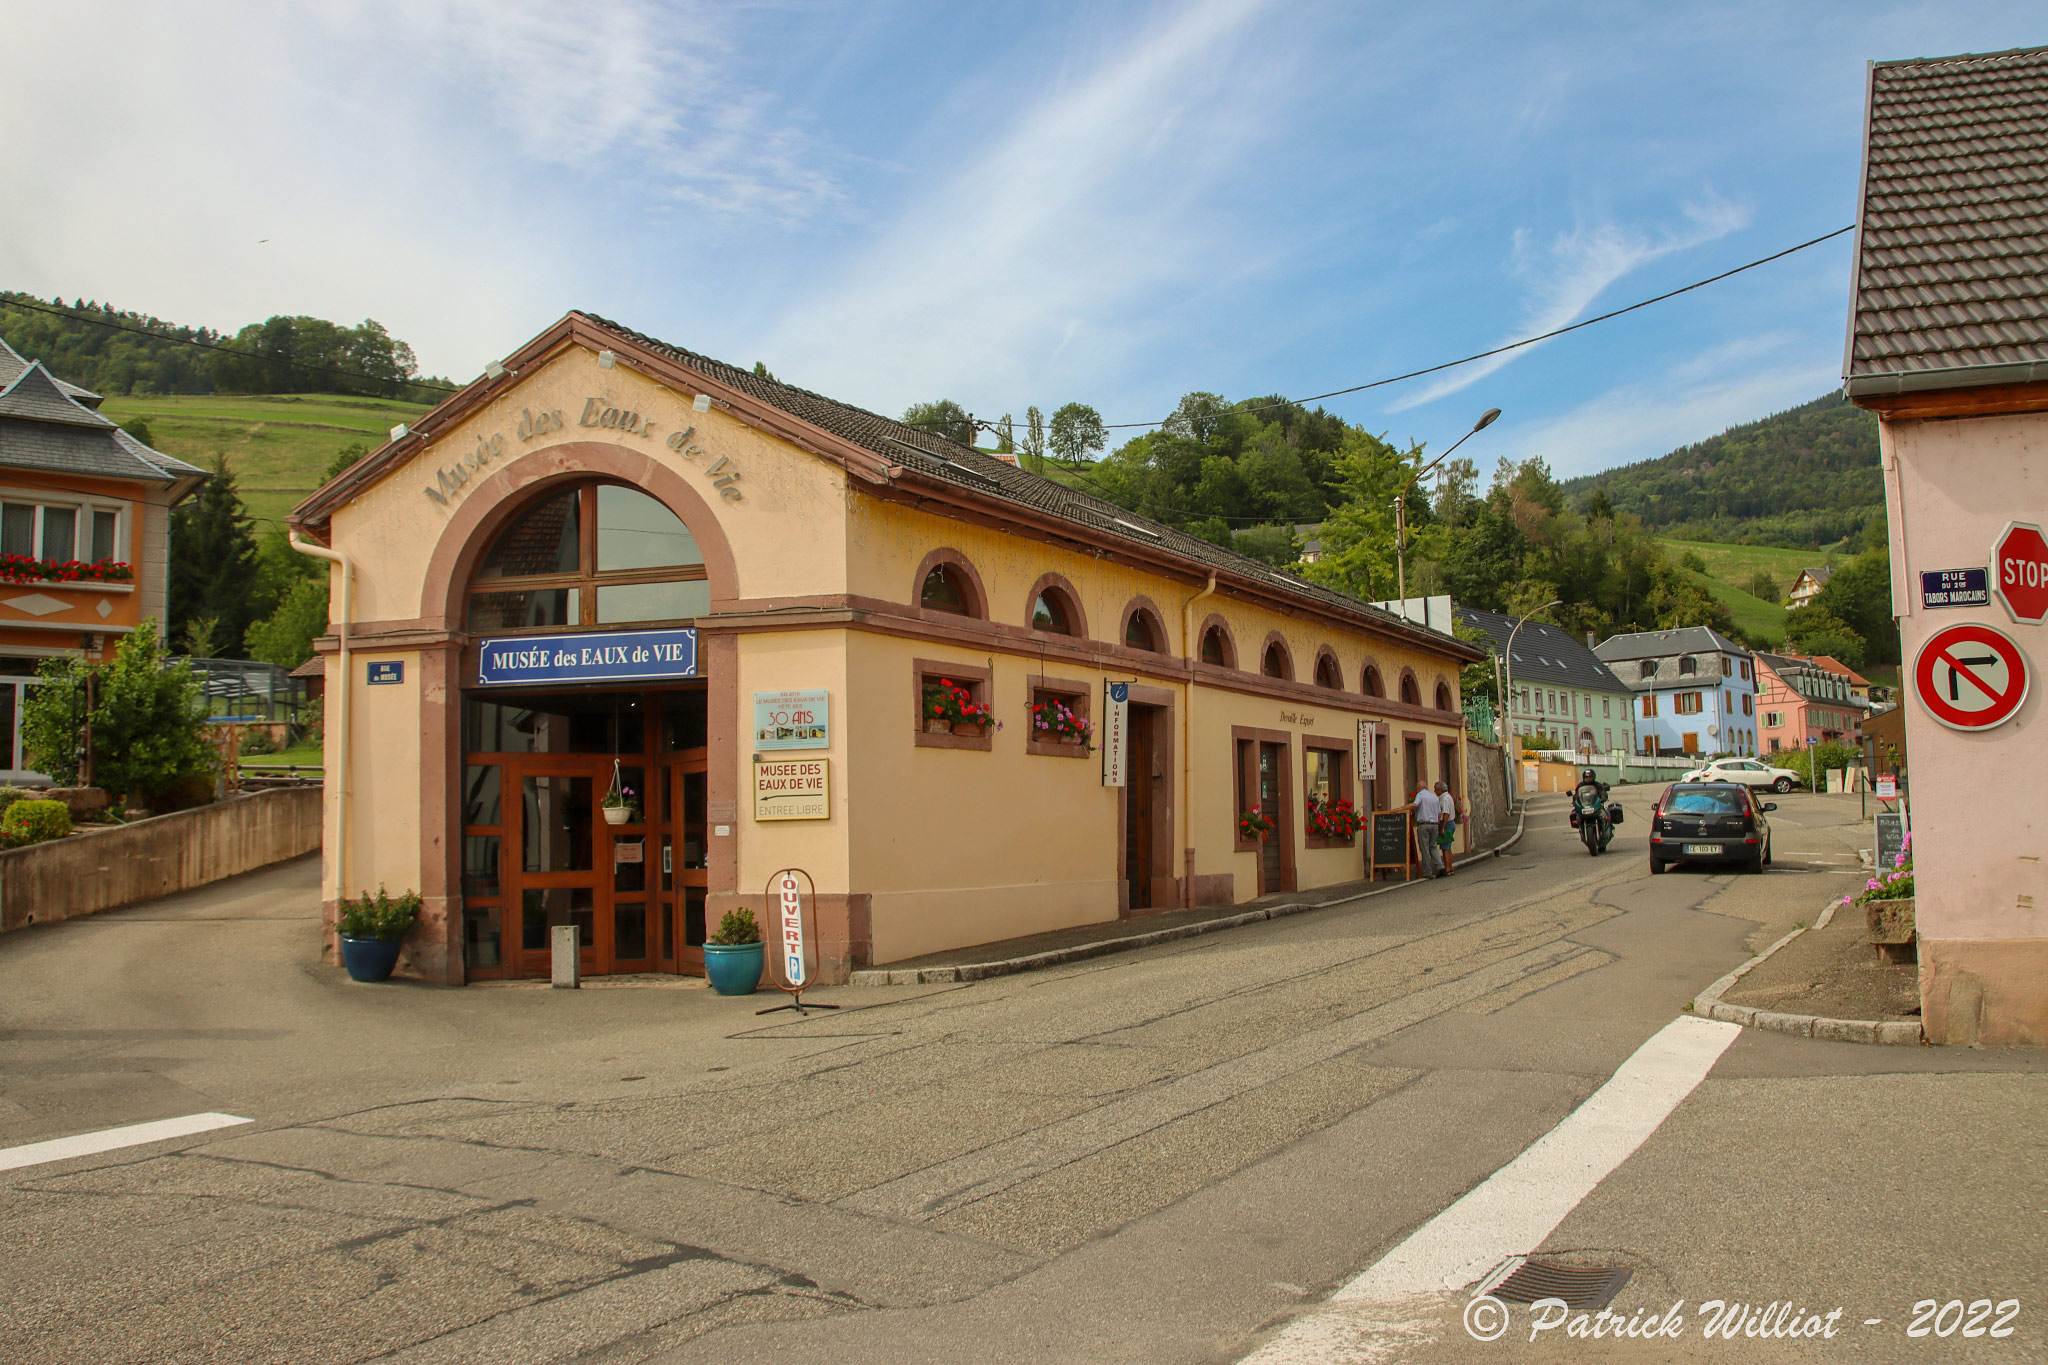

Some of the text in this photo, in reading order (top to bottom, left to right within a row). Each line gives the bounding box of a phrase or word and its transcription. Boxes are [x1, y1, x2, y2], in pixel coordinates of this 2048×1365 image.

[424, 397, 743, 508] Musée des Eaux de Vie
[1942, 572, 1966, 582] RUE
[2004, 557, 2048, 589] STOP
[1925, 590, 1986, 604] TABORS MAROCAINS
[492, 643, 683, 670] MUSÉE des EAUX de VIE
[768, 710, 814, 726] 30 ANS
[760, 763, 821, 777] MUSEE DES
[759, 777, 823, 791] EAUX DE VIE
[759, 804, 824, 816] ENTREE LIBRE
[782, 879, 801, 954] OUVERT
